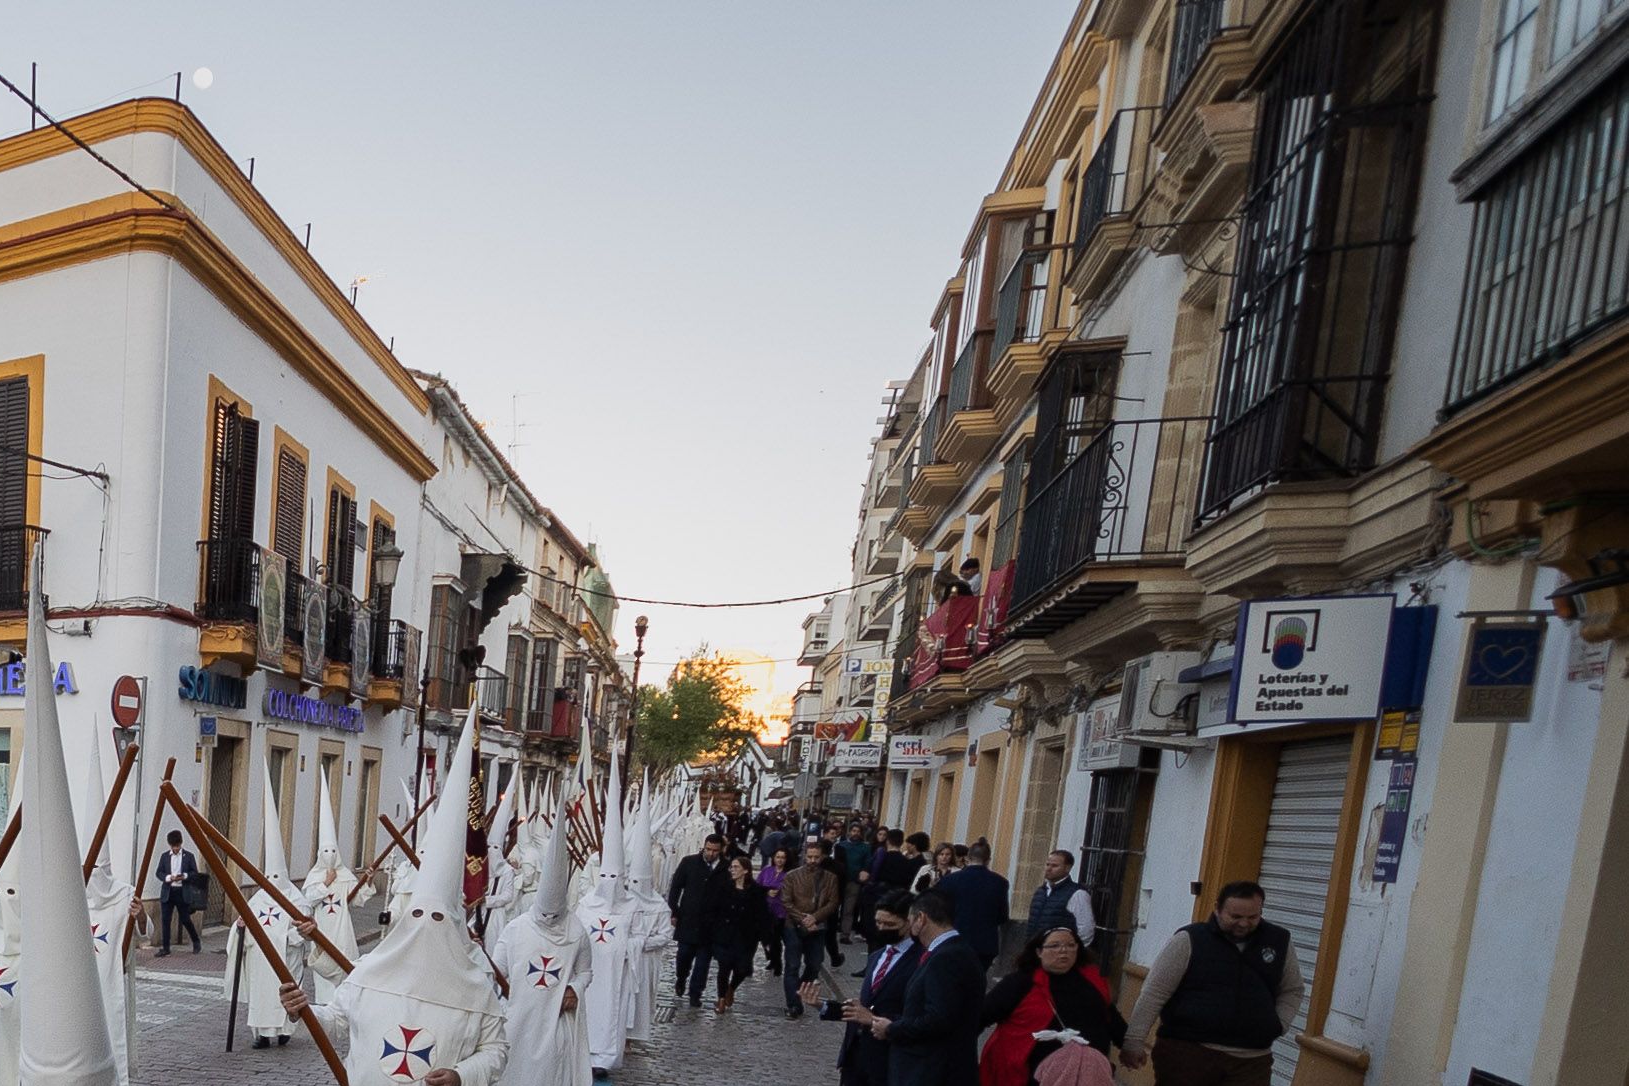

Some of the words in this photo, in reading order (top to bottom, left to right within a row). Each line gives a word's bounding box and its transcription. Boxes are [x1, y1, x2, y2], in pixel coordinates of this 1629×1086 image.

[1258, 672, 1316, 685] Loterías
[1319, 674, 1329, 685] y
[1257, 687, 1323, 699] Apuestas
[1326, 685, 1349, 696] del
[1255, 701, 1304, 712] Estado
